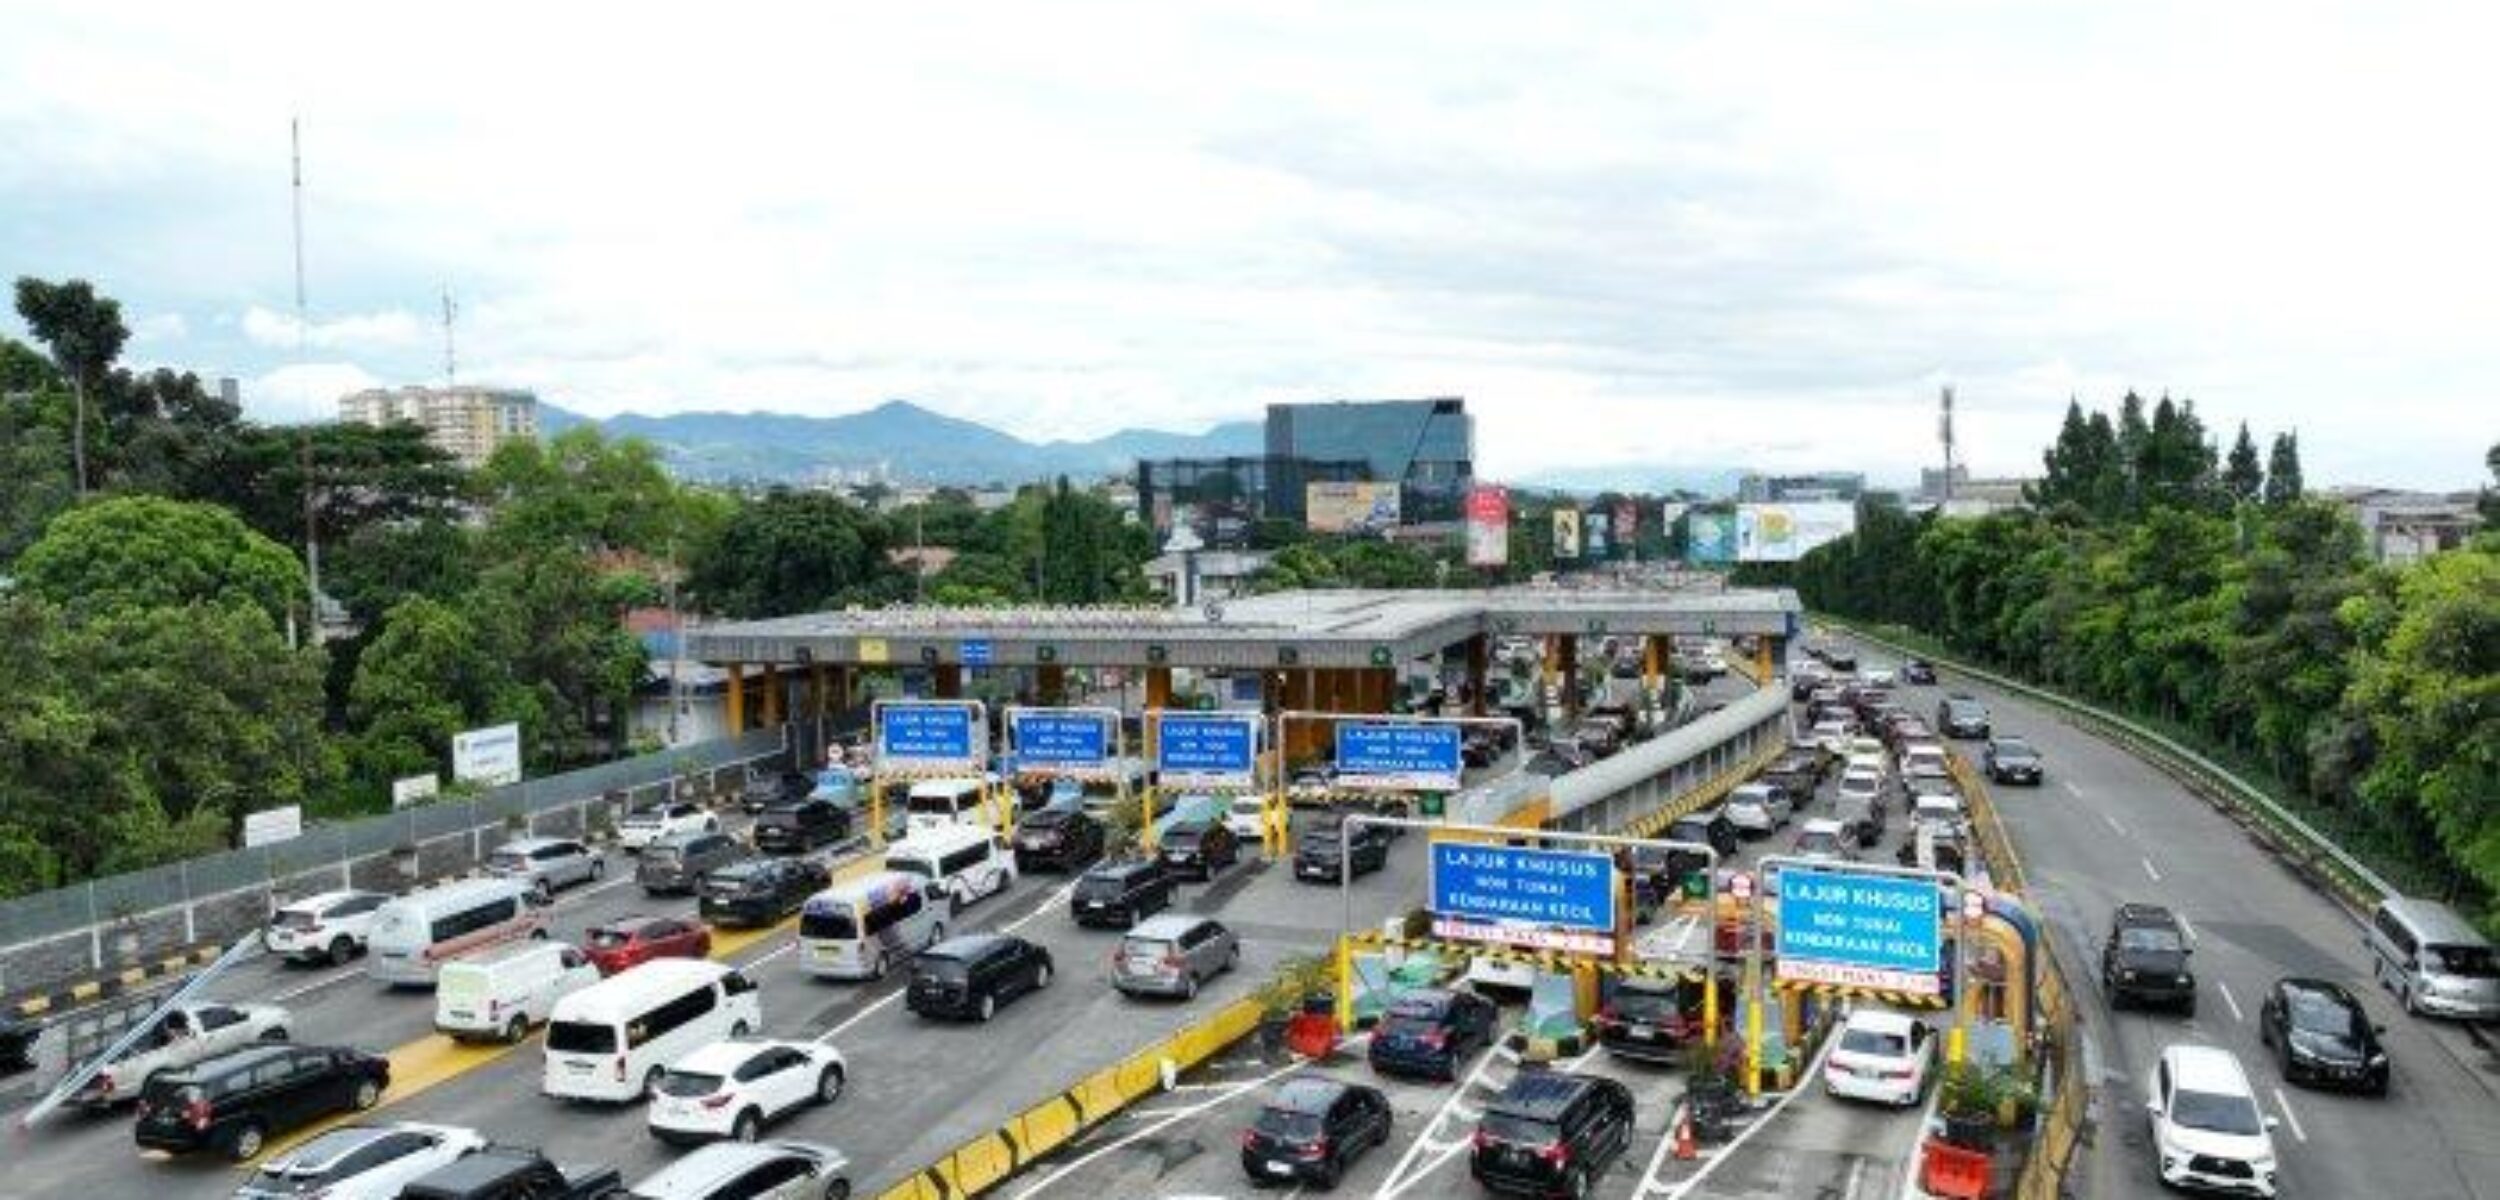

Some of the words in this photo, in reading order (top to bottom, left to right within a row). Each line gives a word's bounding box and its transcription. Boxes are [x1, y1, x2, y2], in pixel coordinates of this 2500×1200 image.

[1446, 850, 1507, 869] LAJUR
[1516, 857, 1598, 876] KHUSUS
[1475, 875, 1508, 890] NON
[1516, 879, 1565, 896] TUNAI
[1785, 883, 1847, 904] LAJUR
[1852, 888, 1931, 912] KHUSUS
[1549, 903, 1594, 921] KECIL
[1813, 911, 1847, 926] NON
